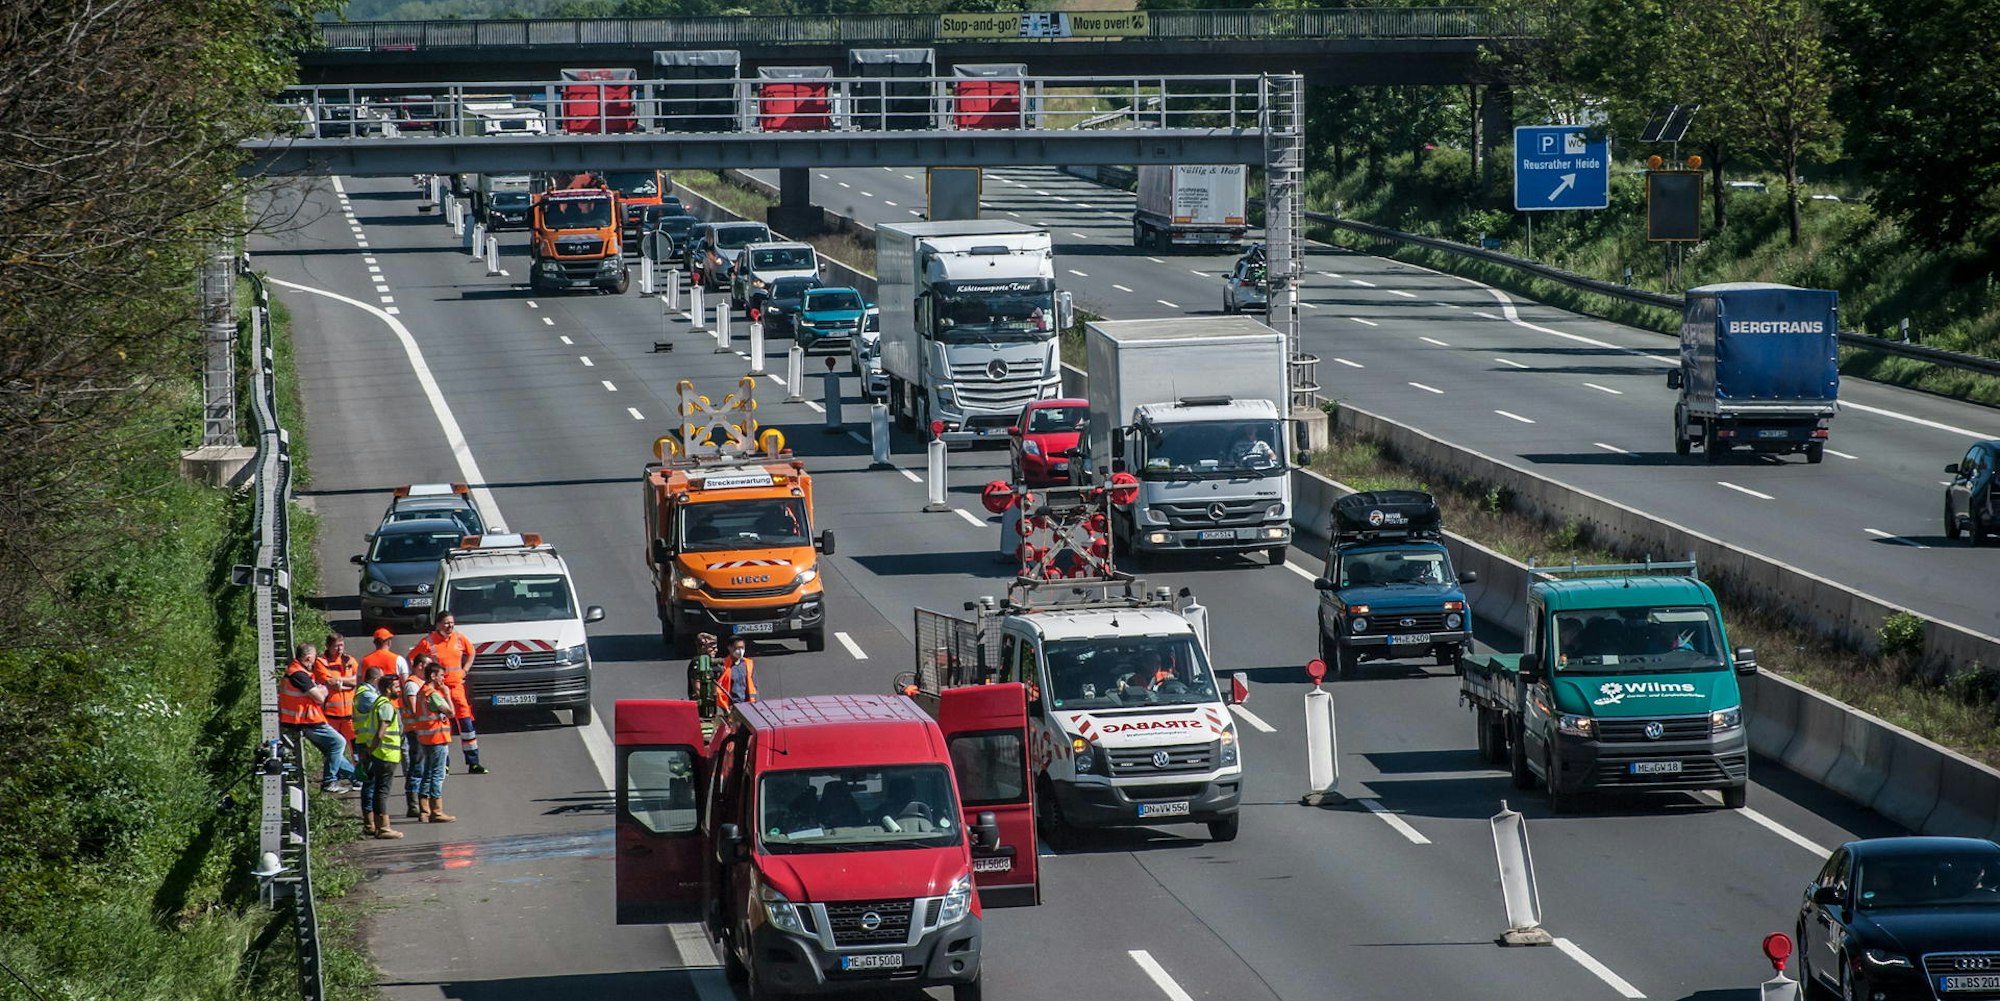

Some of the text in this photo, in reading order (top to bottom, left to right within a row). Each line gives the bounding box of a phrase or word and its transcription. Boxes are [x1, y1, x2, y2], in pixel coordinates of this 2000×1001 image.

[943, 14, 1130, 33] Stop-and-go? Move over!
[1542, 136, 1554, 152] P
[1523, 158, 1600, 170] Reusrather Heide
[1729, 321, 1823, 334] BERGTRANS
[707, 477, 771, 487] Streckenwartung
[731, 575, 770, 585] IVECO
[1624, 682, 1695, 693] Wilms
